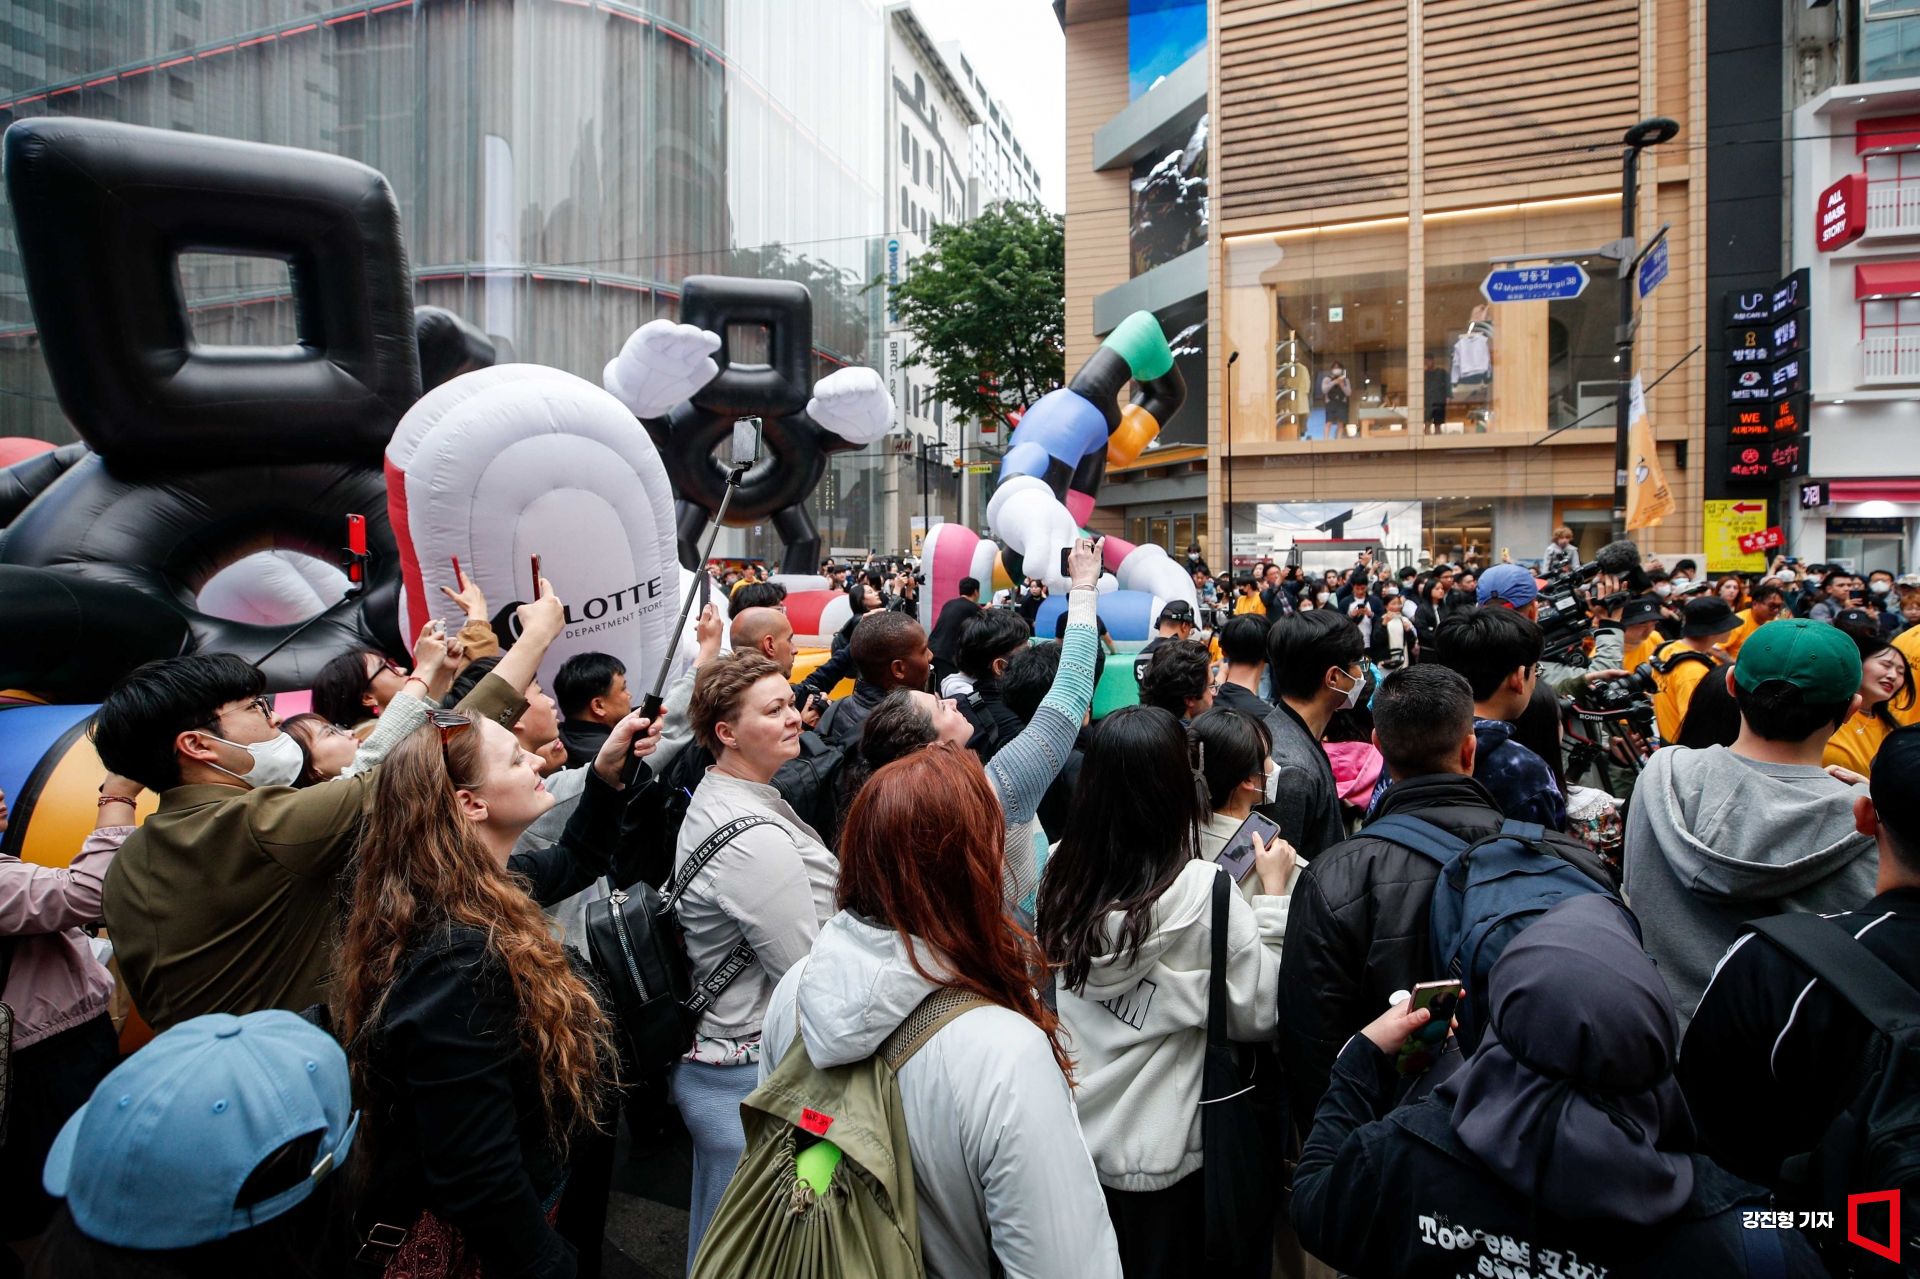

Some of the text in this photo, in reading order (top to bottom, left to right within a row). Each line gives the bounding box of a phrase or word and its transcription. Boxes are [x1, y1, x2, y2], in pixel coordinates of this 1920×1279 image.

[1827, 189, 1843, 208] ALL
[1823, 202, 1846, 226] MASK
[1822, 218, 1847, 242] STORY
[1503, 279, 1566, 292] Myeongdong-gil
[1518, 269, 1550, 283] 명동길
[1740, 412, 1761, 423] WE
[1706, 503, 1728, 514] 입구
[563, 576, 662, 625] LOTTE
[566, 599, 664, 639] DEPARTMENT STORE
[698, 845, 715, 859] EST.
[713, 827, 735, 844] 1981
